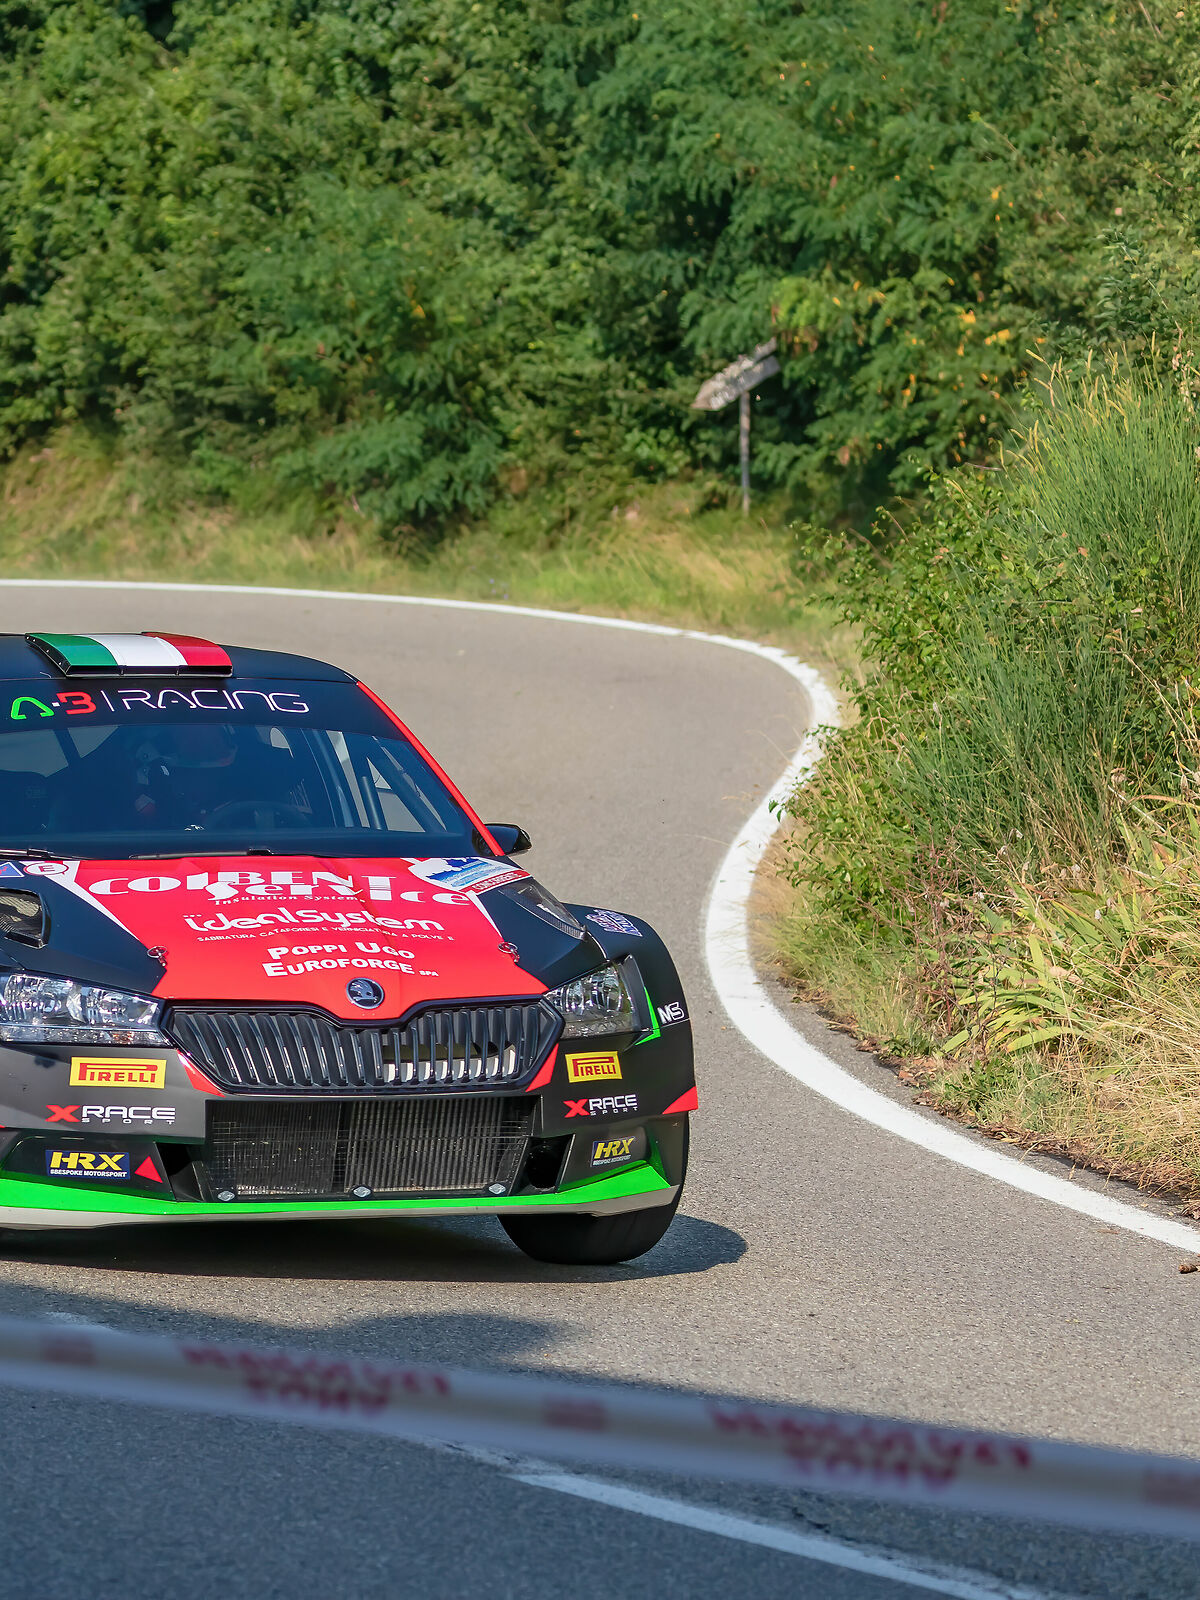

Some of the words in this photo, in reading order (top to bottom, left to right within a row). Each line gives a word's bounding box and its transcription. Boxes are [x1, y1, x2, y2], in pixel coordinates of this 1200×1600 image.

[117, 689, 310, 713] RACING
[38, 865, 55, 873] E
[215, 895, 298, 906] Insulation
[197, 933, 257, 942] SABBIATURA
[267, 944, 348, 960] POPPI
[261, 958, 416, 978] EUROFORGE
[78, 1062, 159, 1083] PIRELLI
[572, 1056, 617, 1077] PIRELLI
[589, 1106, 638, 1116] SPORT
[81, 1117, 176, 1125] SPORT
[593, 1137, 636, 1160] HRX
[49, 1151, 126, 1171] HRX
[83, 1169, 128, 1178] MOTORSPORT
